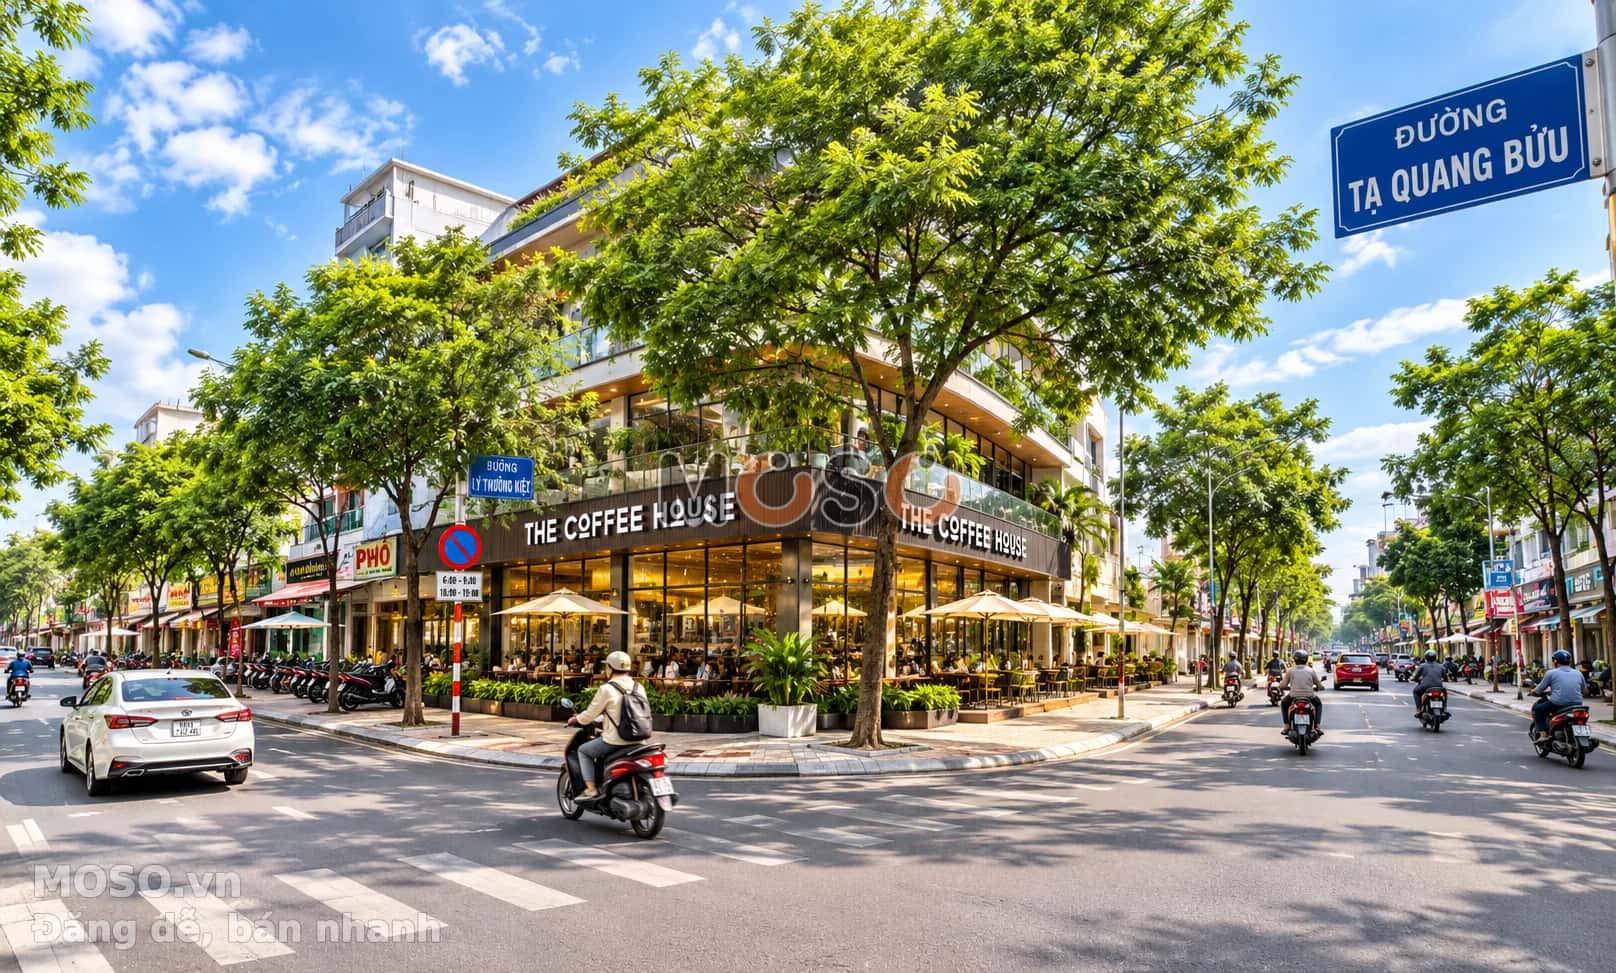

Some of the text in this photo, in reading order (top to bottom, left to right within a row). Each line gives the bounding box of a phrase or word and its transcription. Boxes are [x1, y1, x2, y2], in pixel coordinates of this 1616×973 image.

[1395, 98, 1507, 149] ĐƯỜNG
[1348, 123, 1569, 215] TẠ QUANG BỬU
[525, 492, 735, 546] THE COFFEE HOUSE
[901, 502, 1027, 559] THE COFFEE HOUSE
